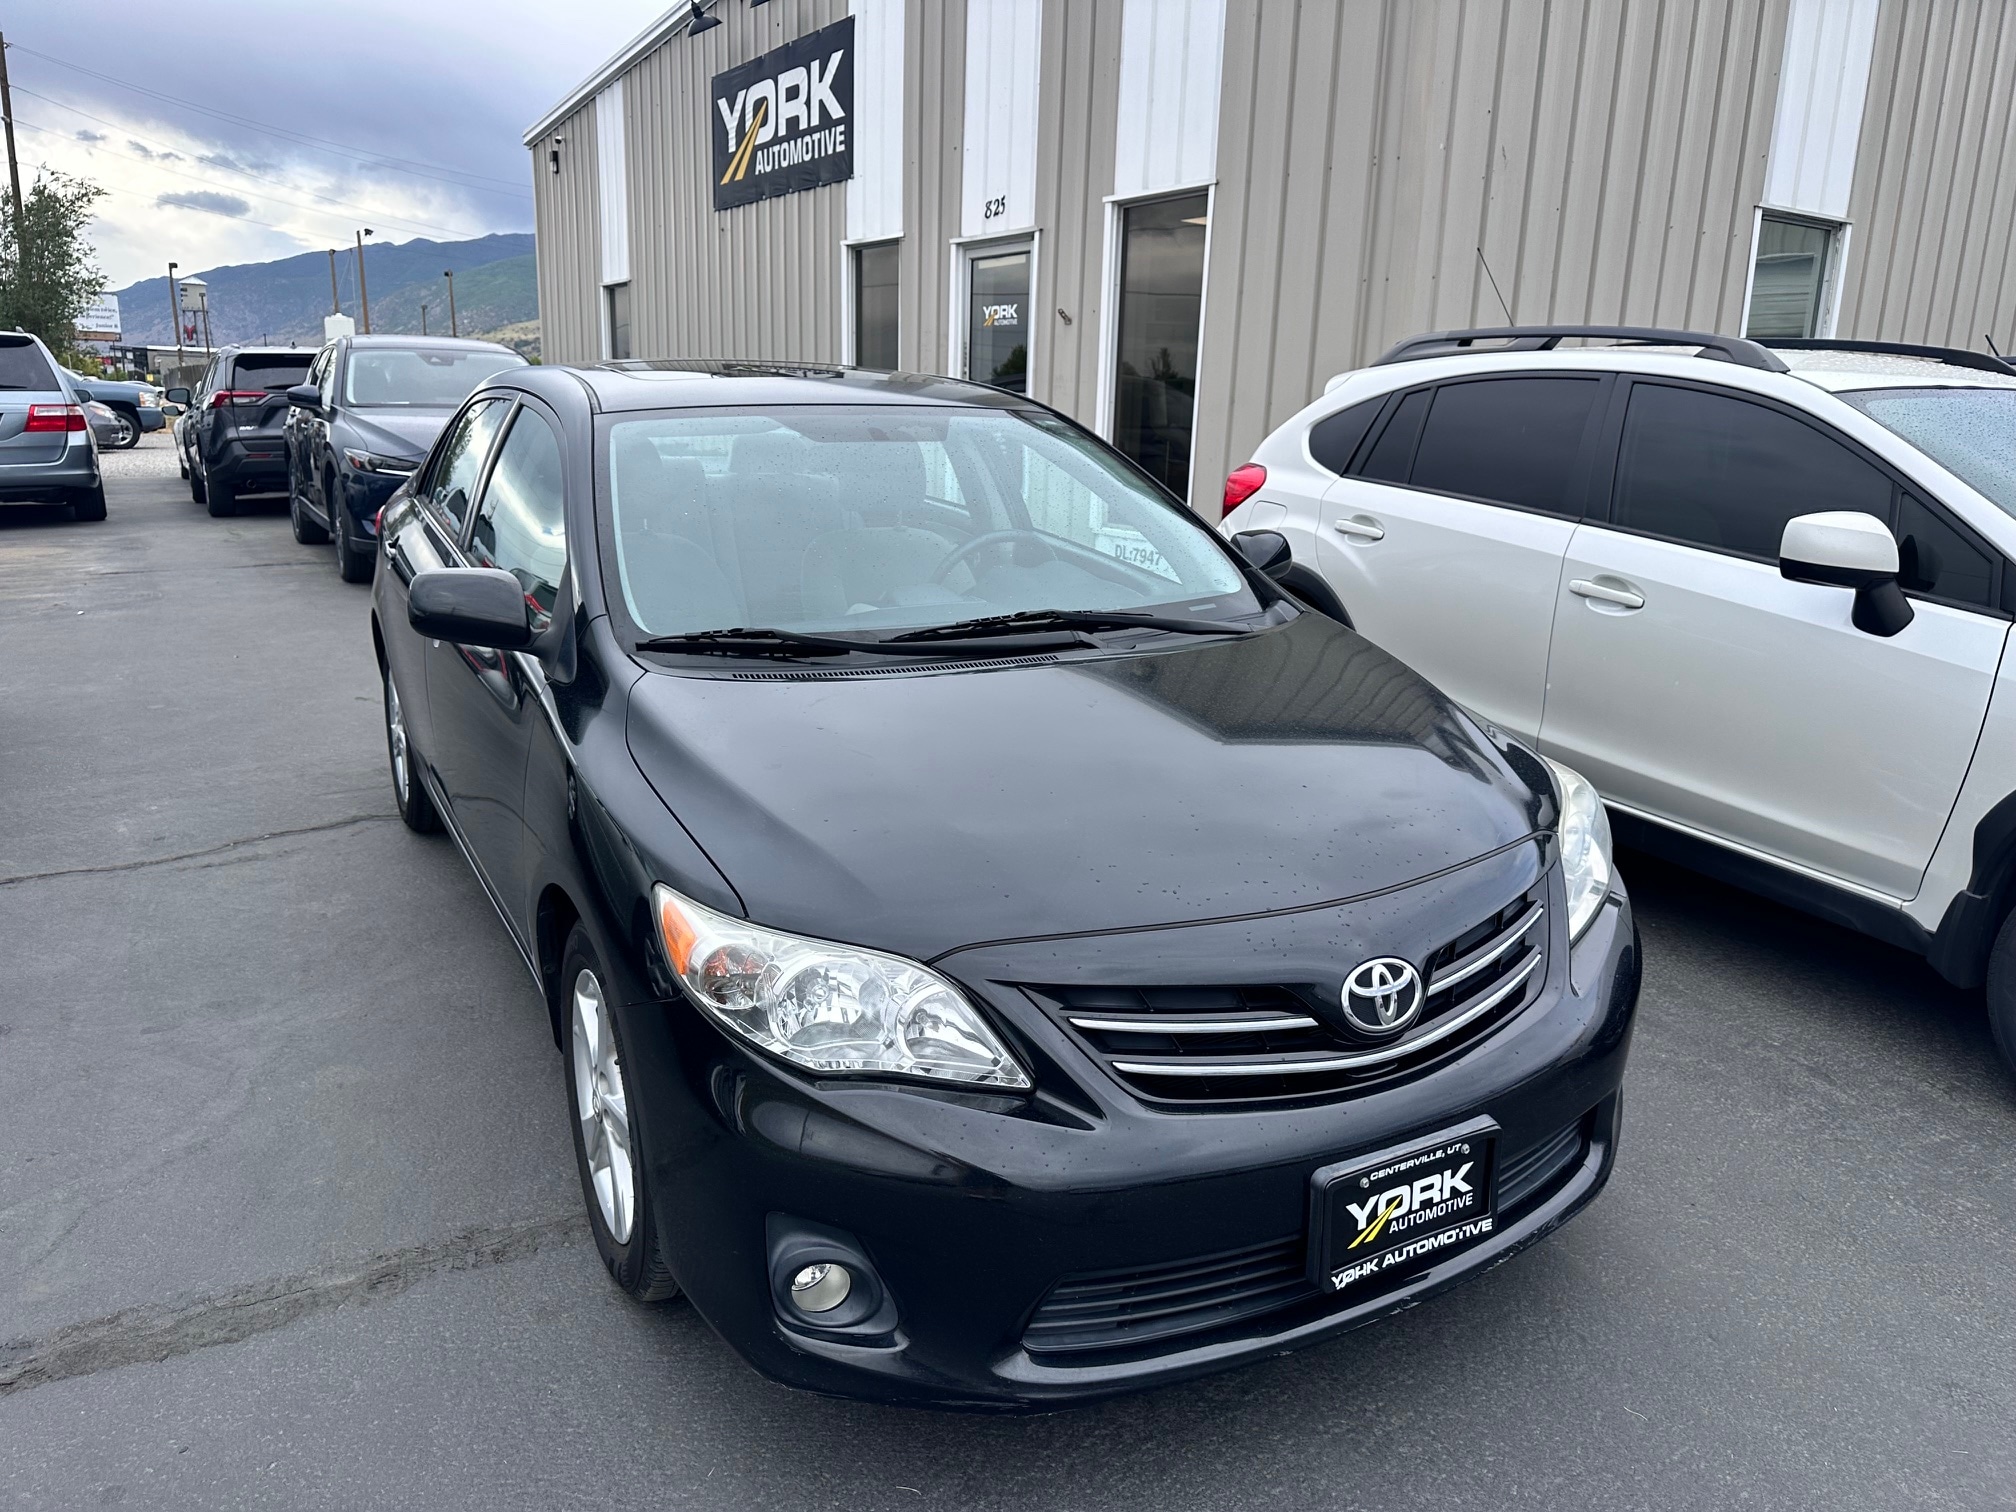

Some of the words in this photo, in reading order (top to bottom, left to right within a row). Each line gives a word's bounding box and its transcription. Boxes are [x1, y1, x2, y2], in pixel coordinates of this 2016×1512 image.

[716, 48, 846, 154] YORK
[755, 124, 846, 176] AUTOMOTIVE
[984, 194, 1006, 219] 825
[982, 303, 1018, 319] YORK
[1369, 1148, 1446, 1181] CENTERVILLE,
[1446, 1142, 1462, 1155] UT
[1345, 1160, 1475, 1231] YORK
[1388, 1192, 1474, 1234] AUTOMOTIVE
